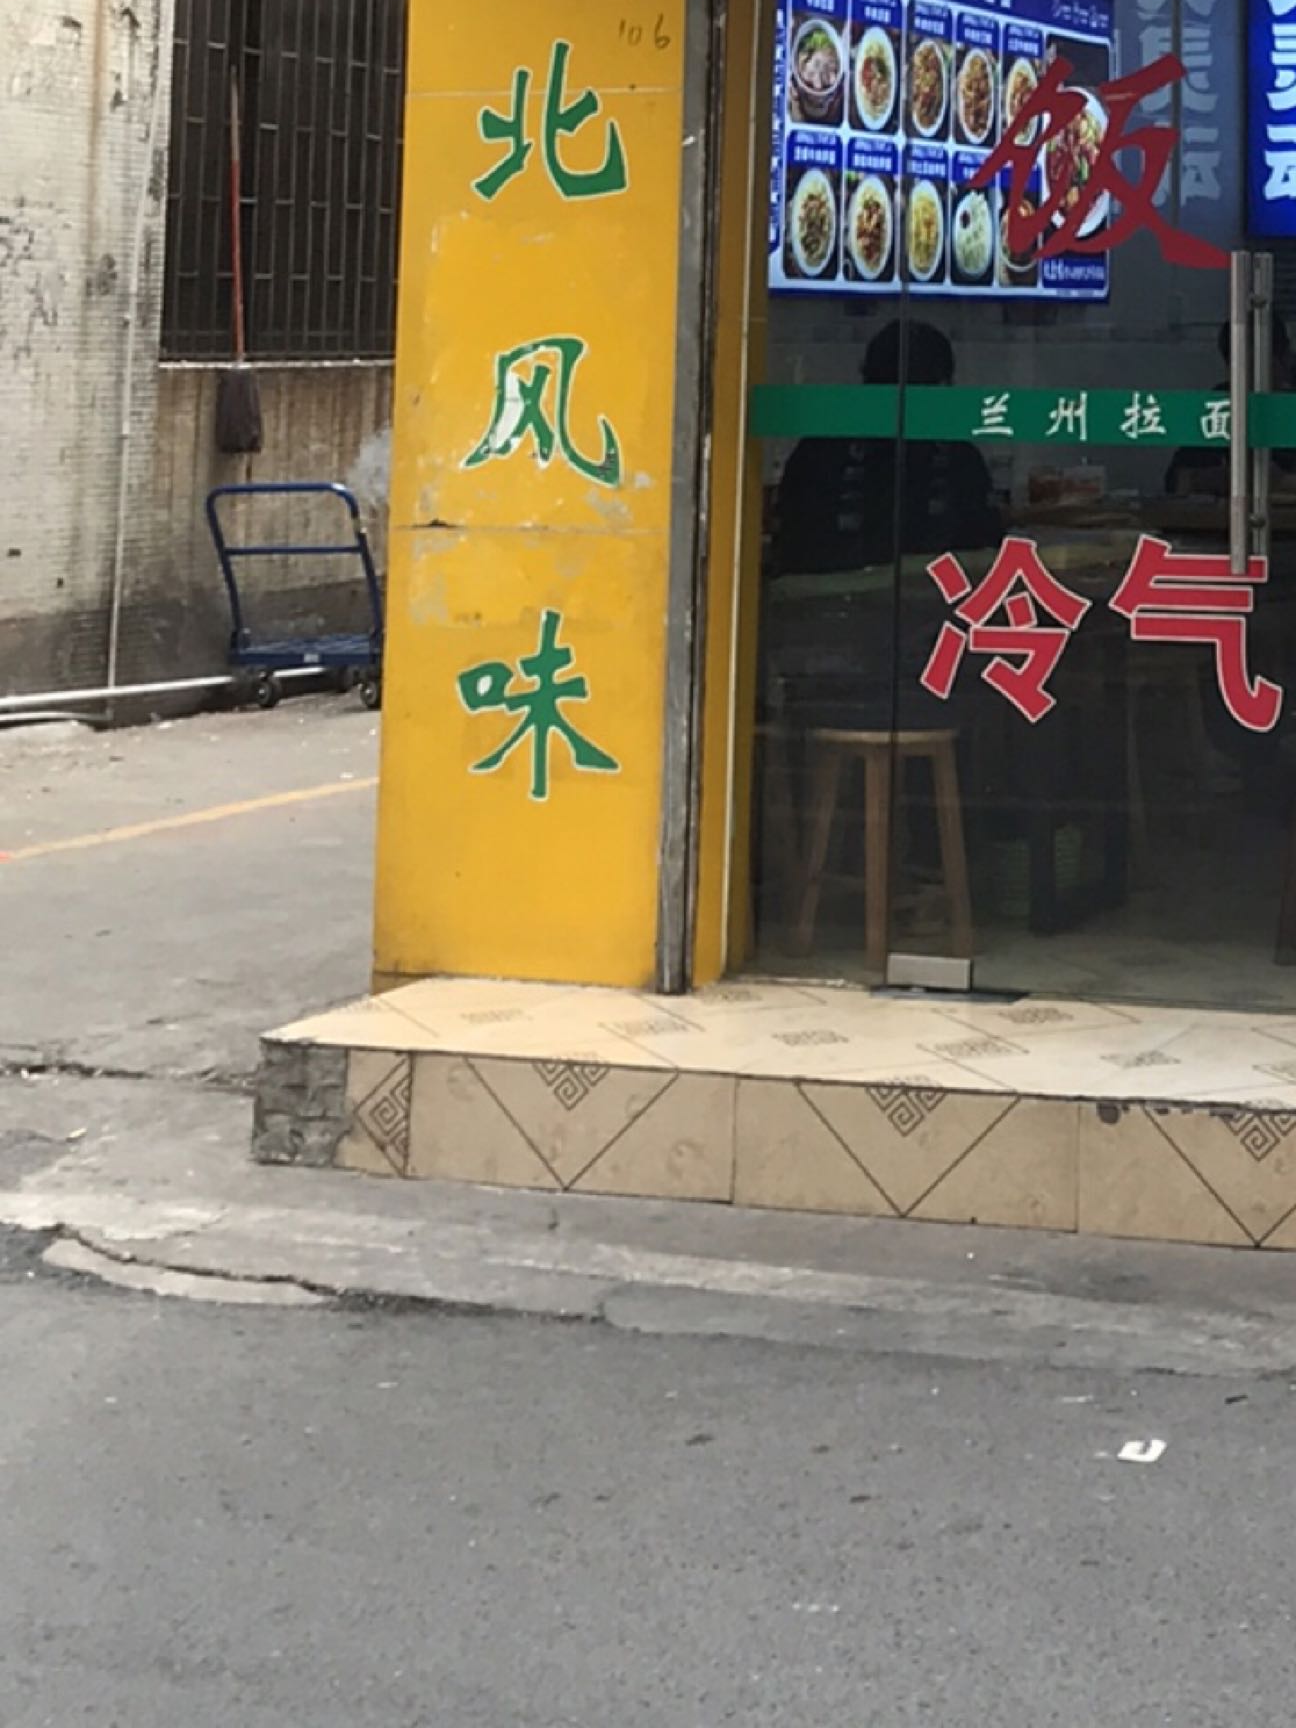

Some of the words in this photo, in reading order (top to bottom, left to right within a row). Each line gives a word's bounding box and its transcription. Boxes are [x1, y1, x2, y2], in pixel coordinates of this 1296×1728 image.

[972, 391, 1233, 442] 兰州拉面
[920, 533, 1284, 733] 冷气
